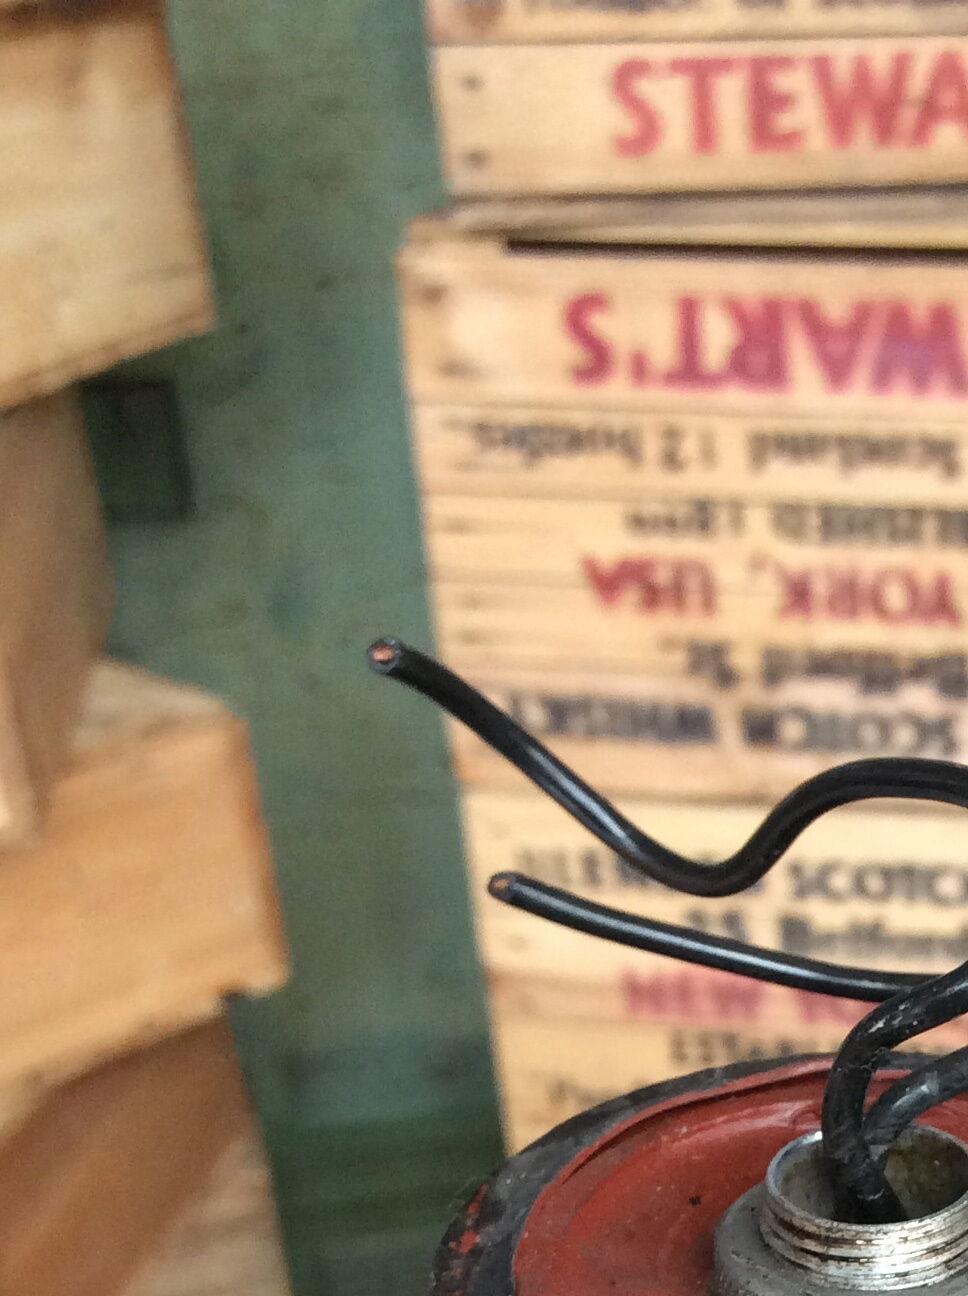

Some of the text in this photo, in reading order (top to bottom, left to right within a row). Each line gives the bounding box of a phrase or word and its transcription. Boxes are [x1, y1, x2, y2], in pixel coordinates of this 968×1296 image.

[659, 422, 717, 472] 12
[578, 553, 717, 618] USA
[742, 705, 957, 757] SCOTCH
